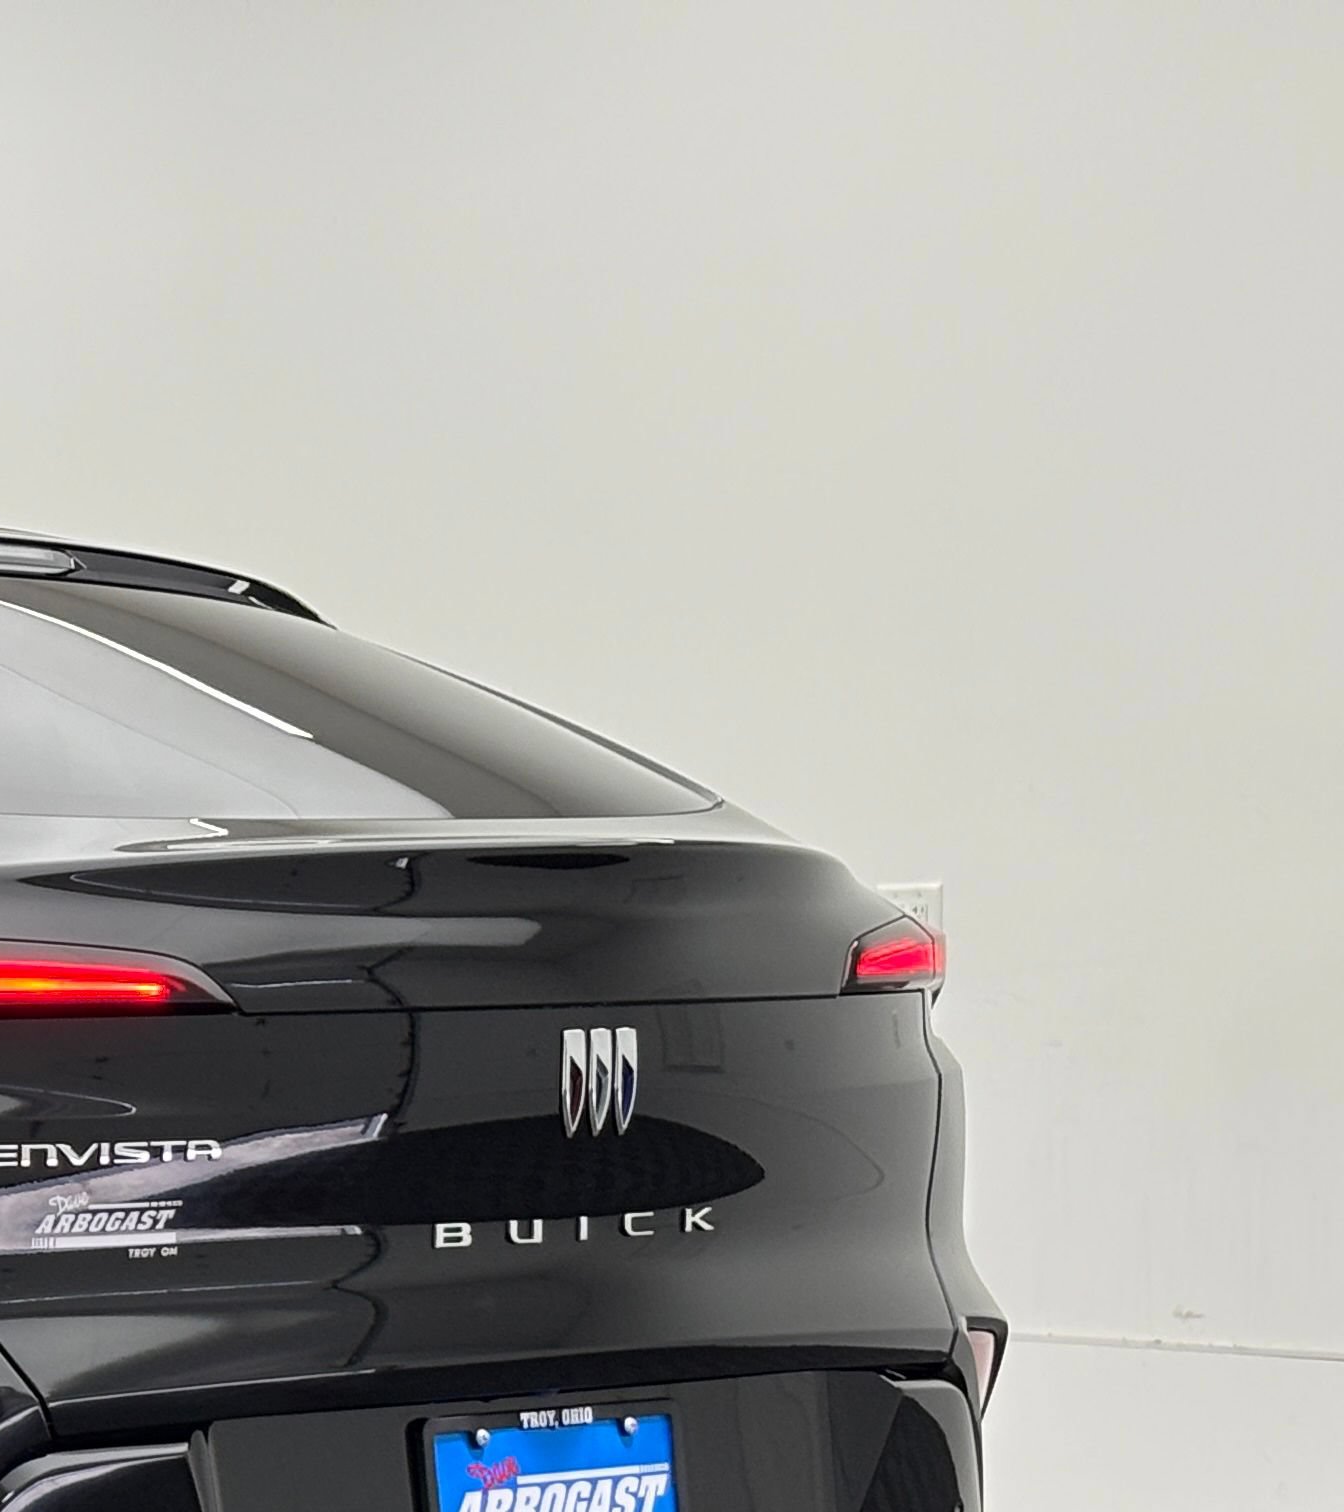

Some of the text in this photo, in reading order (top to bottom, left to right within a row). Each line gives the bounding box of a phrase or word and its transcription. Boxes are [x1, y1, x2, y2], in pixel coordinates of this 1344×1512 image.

[35, 1209, 176, 1235] ARBOGAST
[433, 1206, 715, 1249] BUICK
[128, 1247, 155, 1259] TROY
[520, 1406, 594, 1429] TROY, OHIO
